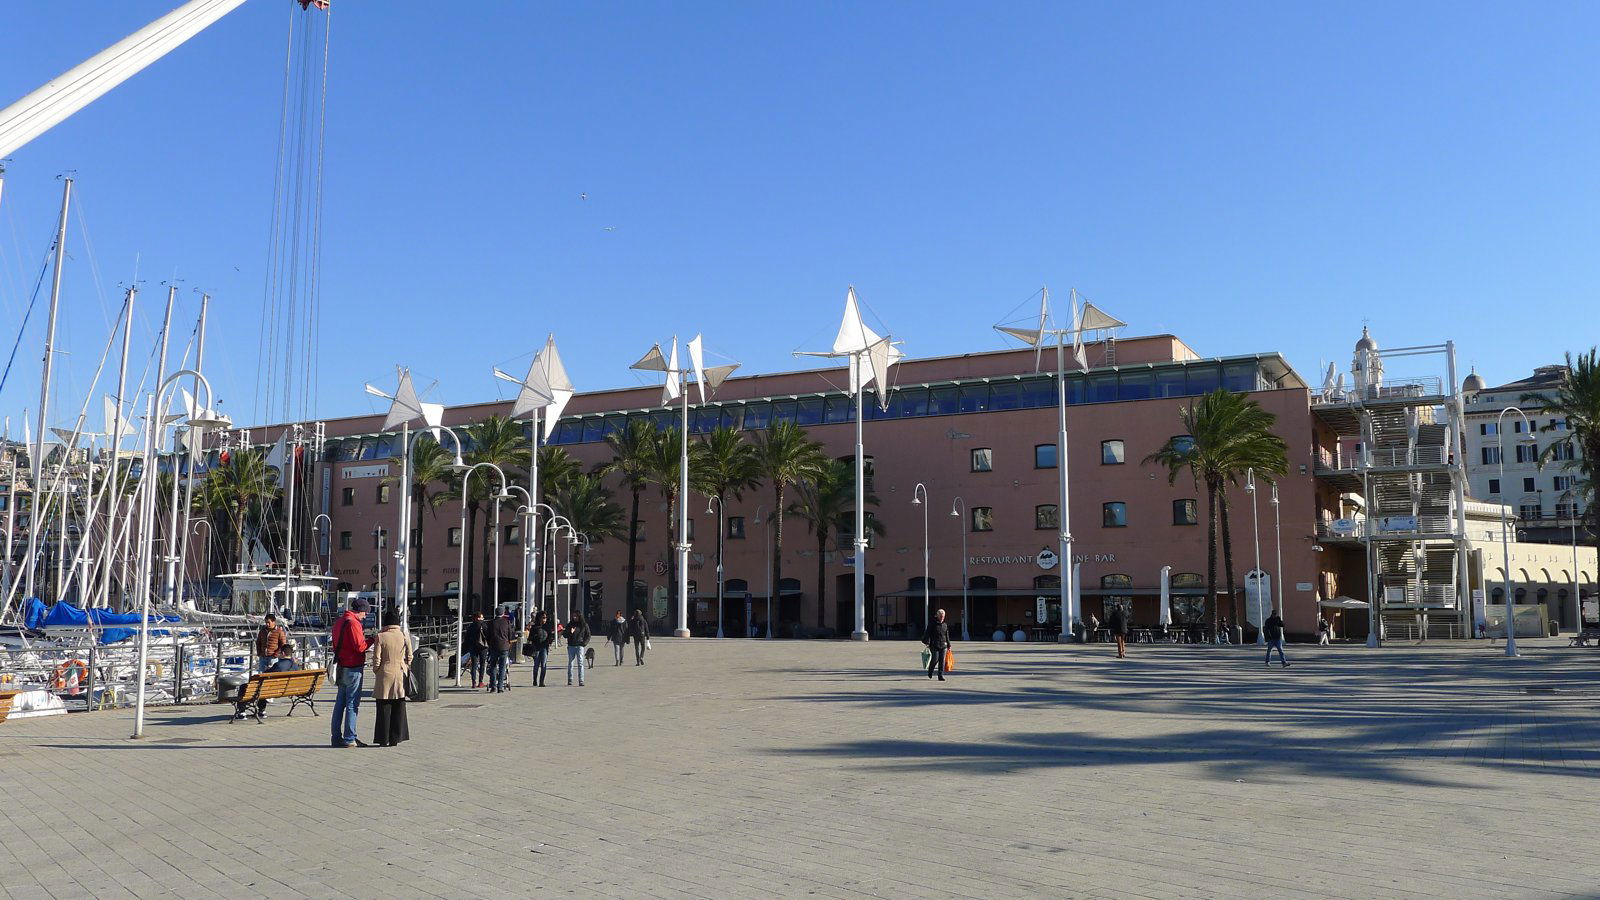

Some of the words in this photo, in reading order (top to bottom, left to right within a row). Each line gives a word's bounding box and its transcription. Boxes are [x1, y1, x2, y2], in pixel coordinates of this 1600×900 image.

[969, 555, 1033, 565] RESTAURANT
[1072, 554, 1089, 563] INE
[1095, 554, 1116, 562] BAR
